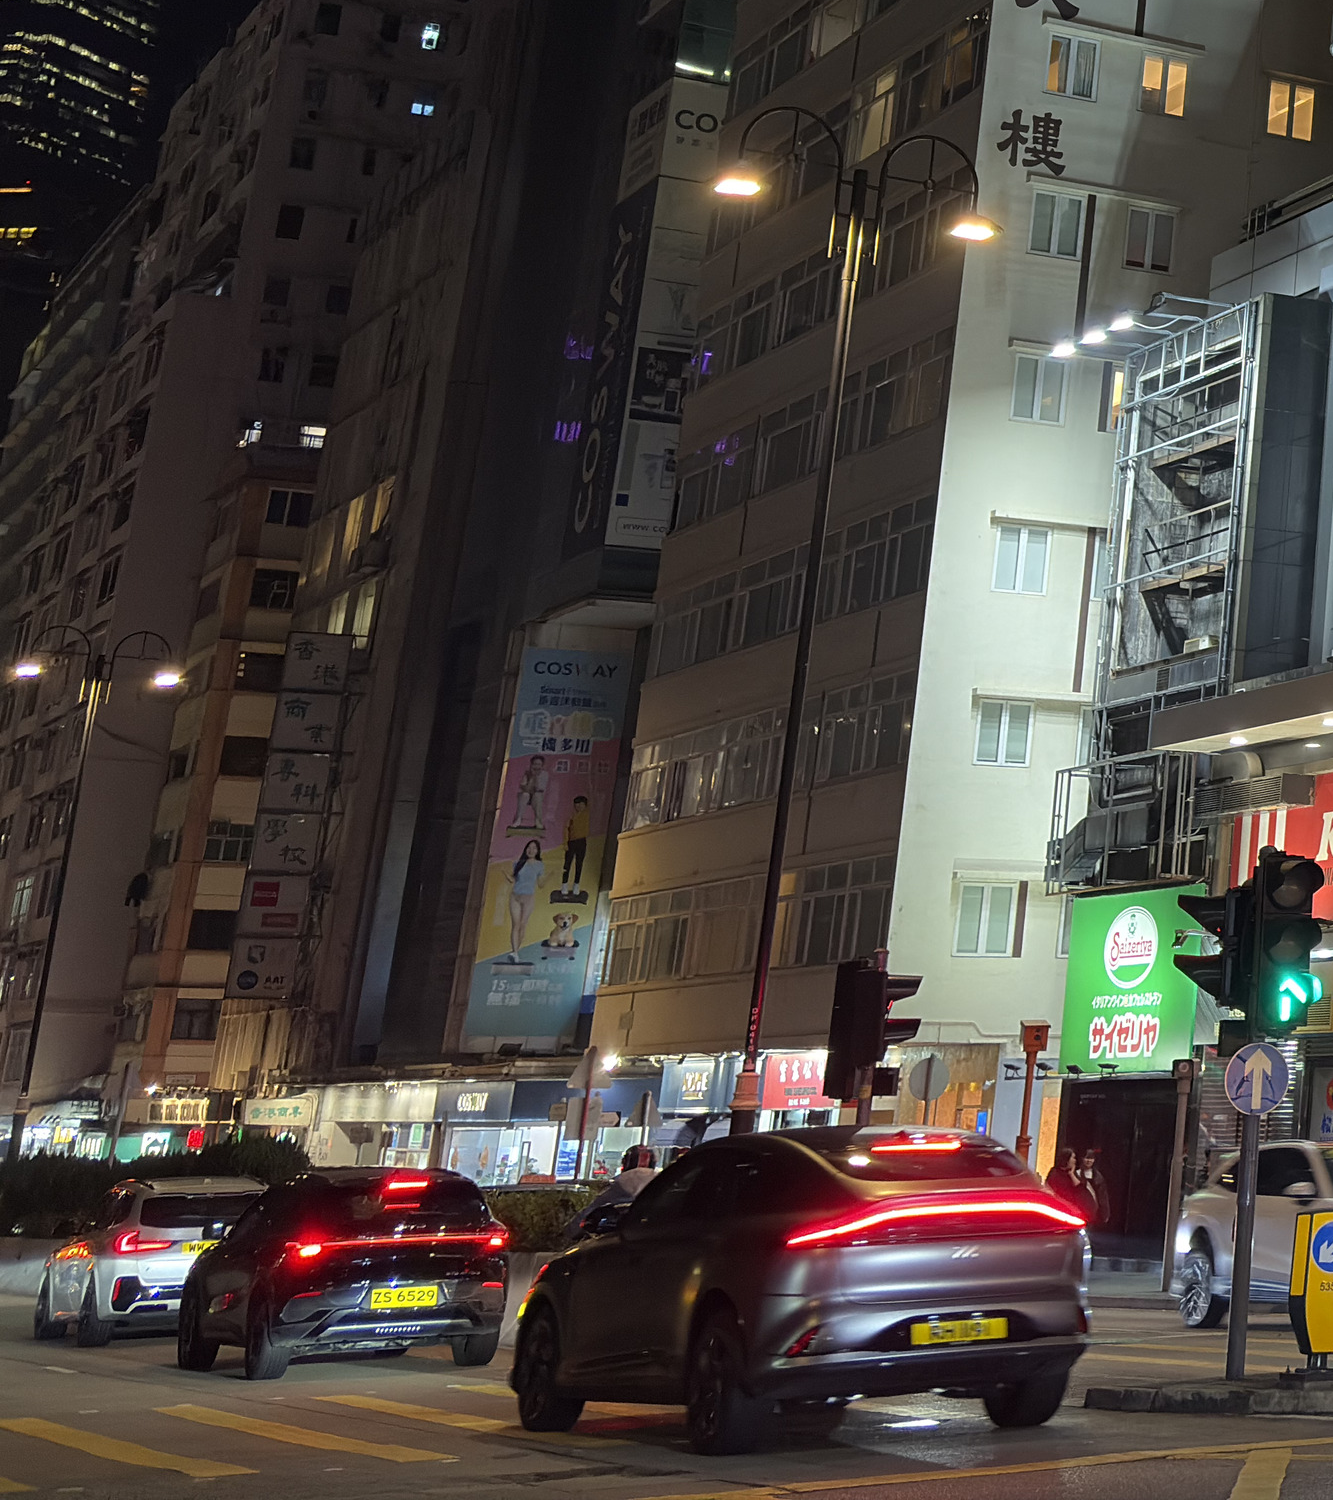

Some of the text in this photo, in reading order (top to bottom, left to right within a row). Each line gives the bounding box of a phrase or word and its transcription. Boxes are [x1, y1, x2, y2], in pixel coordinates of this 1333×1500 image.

[1109, 932, 1153, 963] Saizeriya
[1090, 1014, 1160, 1058] サイゼリヤ
[373, 1289, 436, 1305] ZS 6529
